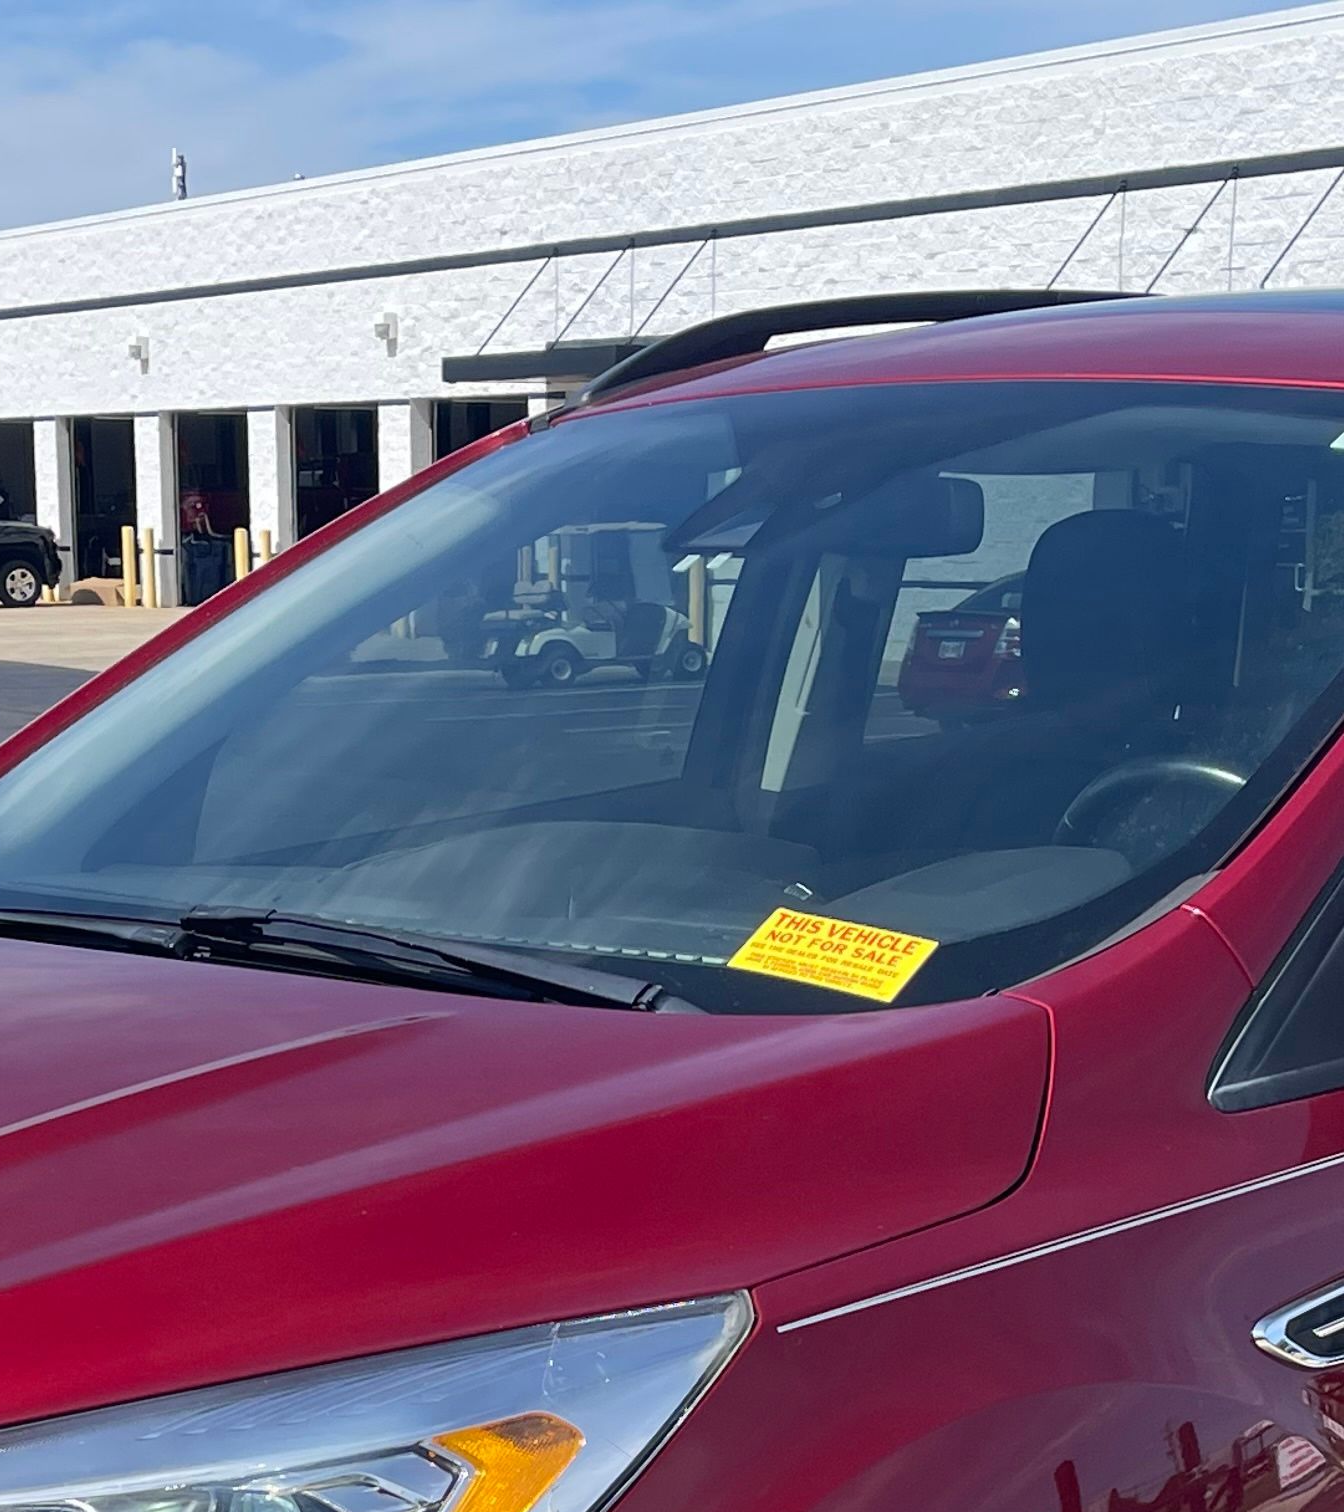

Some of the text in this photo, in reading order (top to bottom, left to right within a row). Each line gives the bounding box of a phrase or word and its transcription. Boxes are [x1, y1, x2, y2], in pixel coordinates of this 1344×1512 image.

[764, 929, 904, 967] NOT FOR SALE
[772, 912, 922, 956] THIS VEHICLE
[820, 955, 839, 964] FOR
